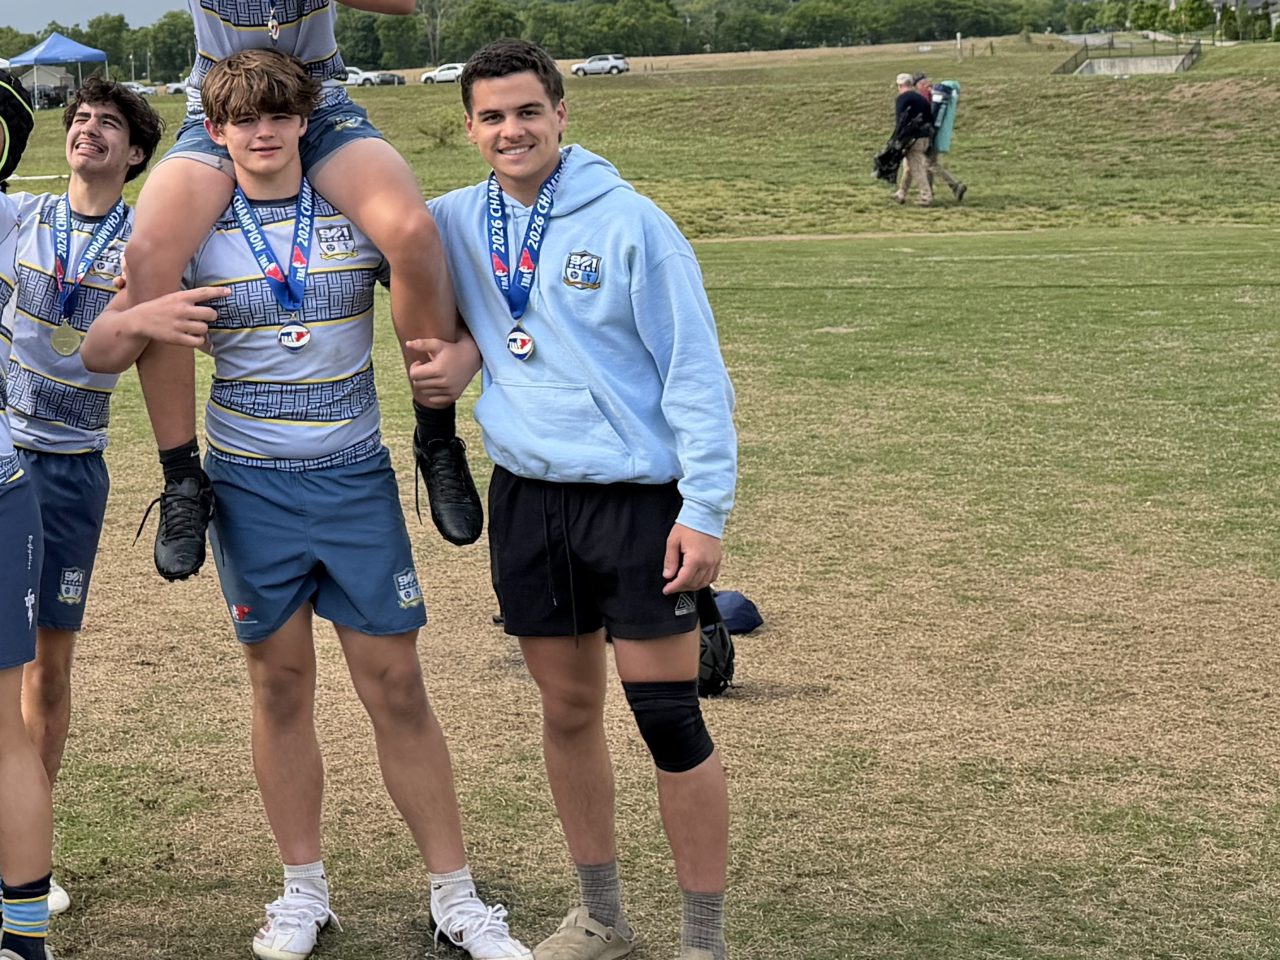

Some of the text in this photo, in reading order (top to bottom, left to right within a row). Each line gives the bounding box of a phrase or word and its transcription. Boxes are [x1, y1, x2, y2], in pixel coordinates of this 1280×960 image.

[84, 211, 120, 261] CHAMPION
[232, 195, 267, 252] CHAMPION
[297, 215, 311, 248] 2026
[489, 176, 505, 253] 2026 CHAM
[527, 214, 545, 251] 2026
[56, 231, 68, 259] 2026
